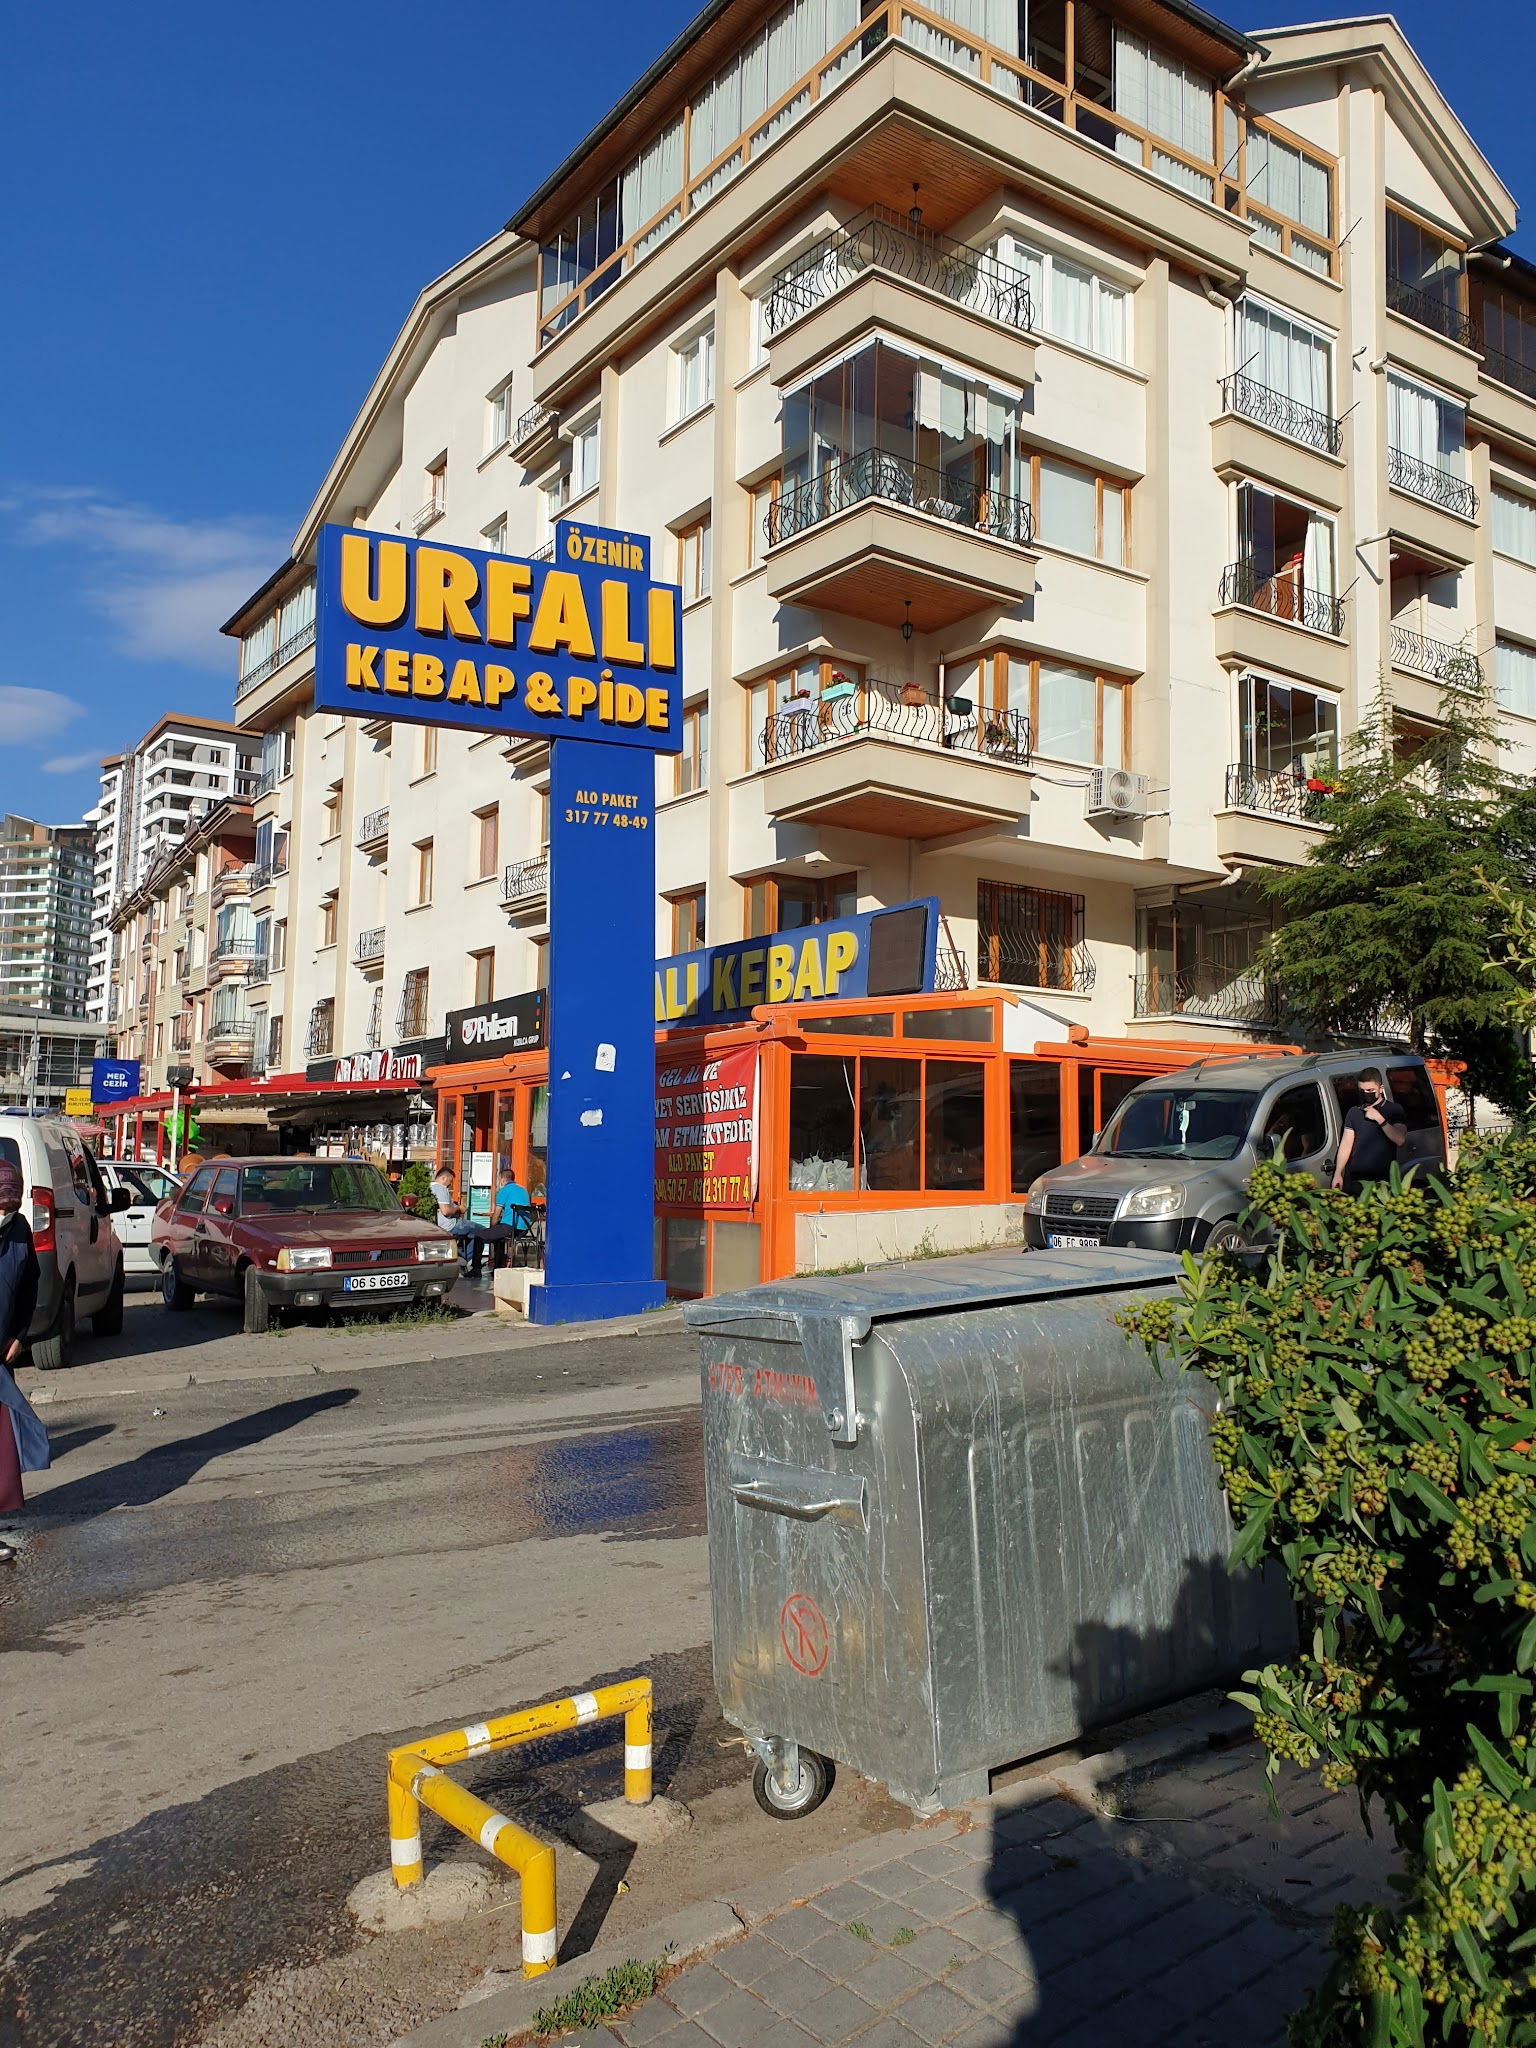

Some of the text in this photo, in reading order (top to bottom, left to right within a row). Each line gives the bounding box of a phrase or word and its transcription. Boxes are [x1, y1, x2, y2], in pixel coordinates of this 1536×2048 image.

[566, 526, 644, 571] ÖZENİR
[341, 533, 676, 669] URFALI
[345, 642, 669, 729] KEBAP & PİDE
[576, 790, 638, 808] ALO PAKET
[565, 809, 648, 829] 317 77 48-49
[712, 930, 860, 1012] KEBAP
[476, 1013, 517, 1043] Polisan
[103, 1079, 129, 1088] CEZİR
[659, 1060, 723, 1087] GEL AL VE
[676, 1082, 747, 1115] SERVİSİMİZ
[685, 1151, 715, 1171] PAKET
[712, 1176, 728, 1202] 317
[729, 1176, 741, 1202] 77
[1053, 1236, 1062, 1248] 06
[352, 1278, 366, 1289] 06
[369, 1277, 377, 1288] S
[379, 1274, 407, 1287] 6682
